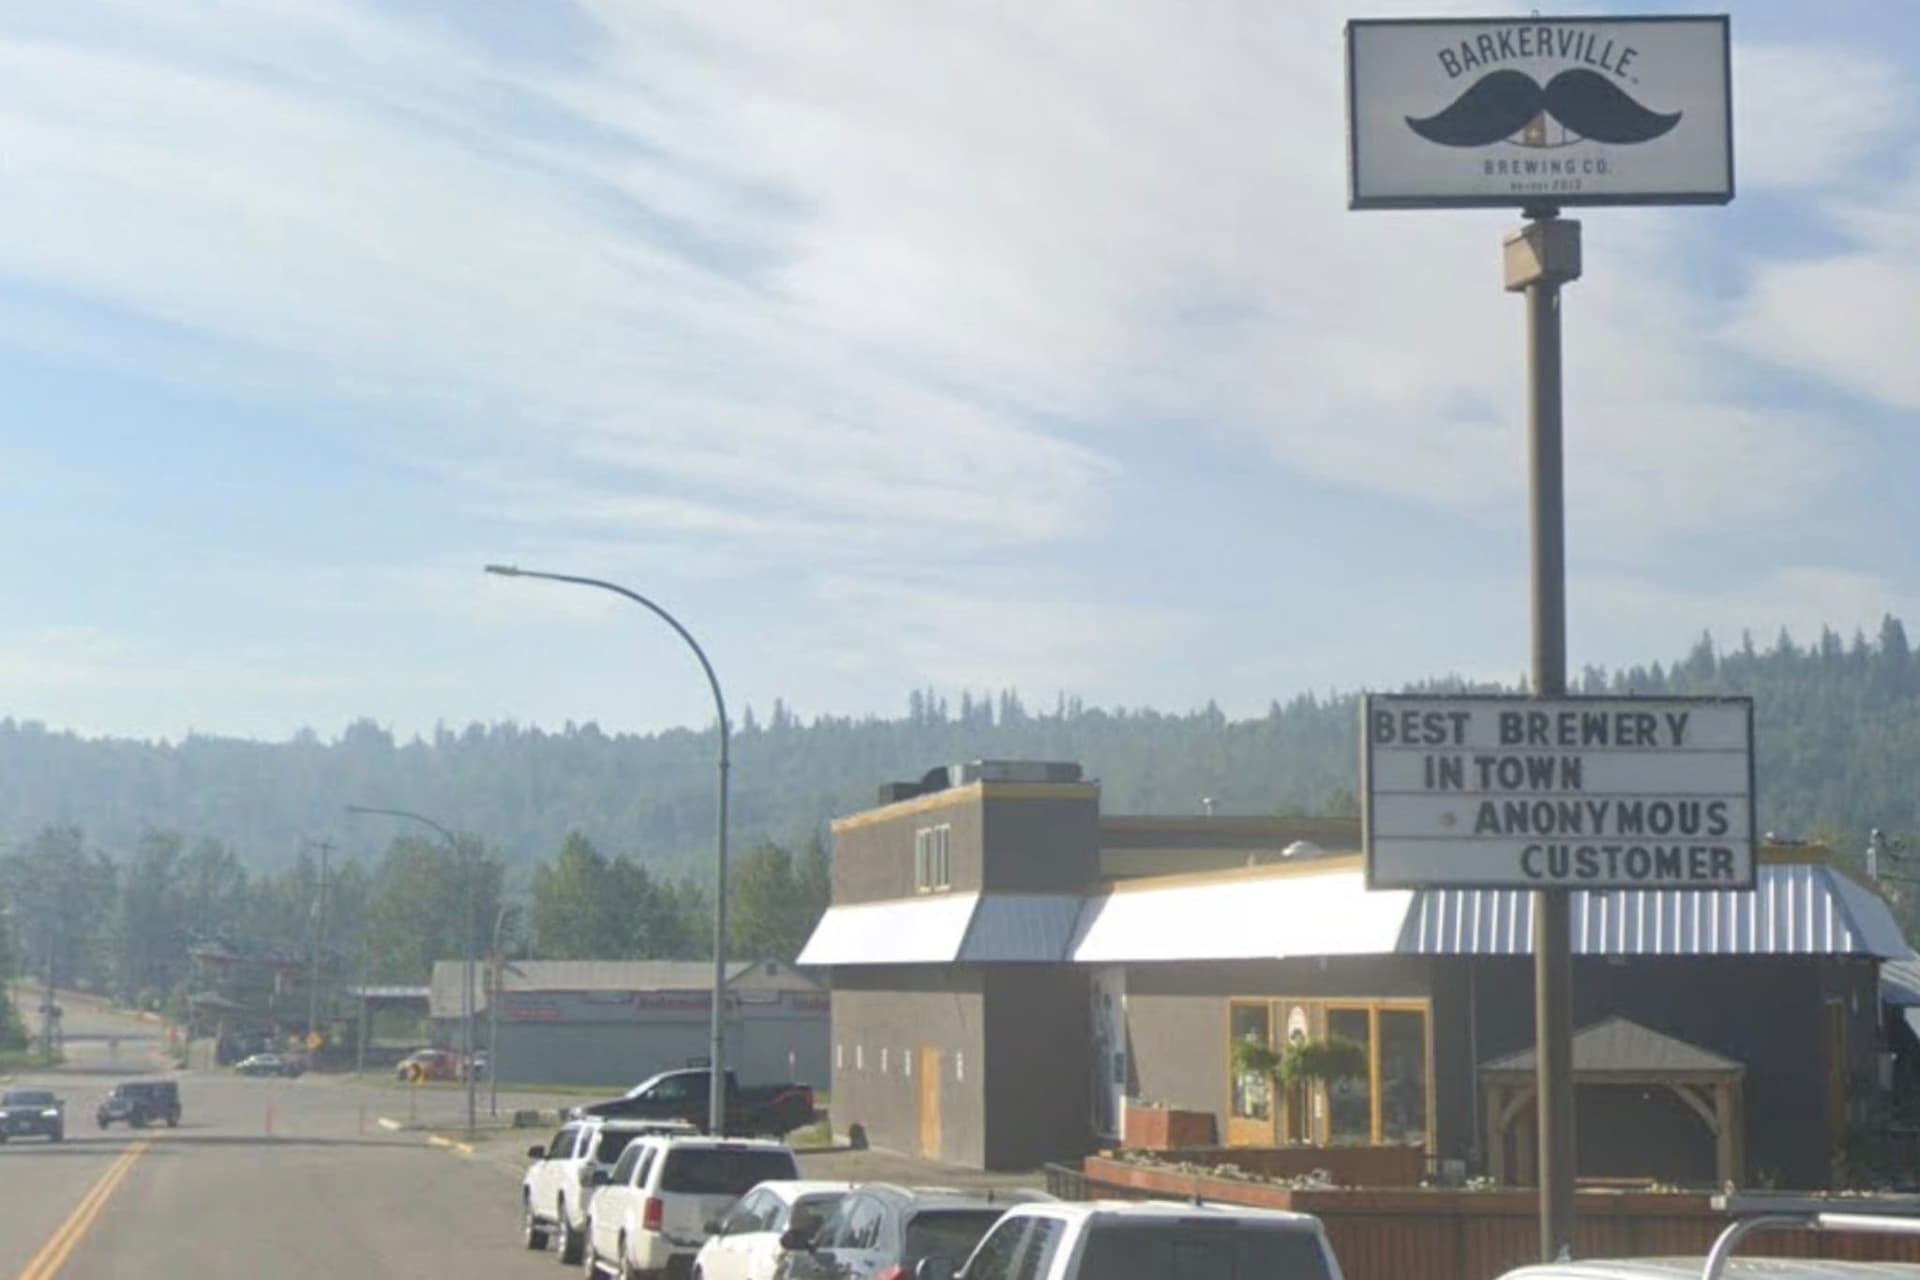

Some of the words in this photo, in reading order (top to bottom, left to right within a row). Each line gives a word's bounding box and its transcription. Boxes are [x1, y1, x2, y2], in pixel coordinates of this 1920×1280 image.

[1484, 159, 1576, 175] BREWING
[1583, 158, 1613, 174] CO.
[1374, 710, 1471, 745] BEST
[1501, 711, 1689, 746] BREWERY
[1425, 755, 1464, 790] IN
[1474, 756, 1583, 790] TOWN
[1474, 801, 1729, 835] ANONYMOUS
[1521, 845, 1735, 880] CUSTOMER
